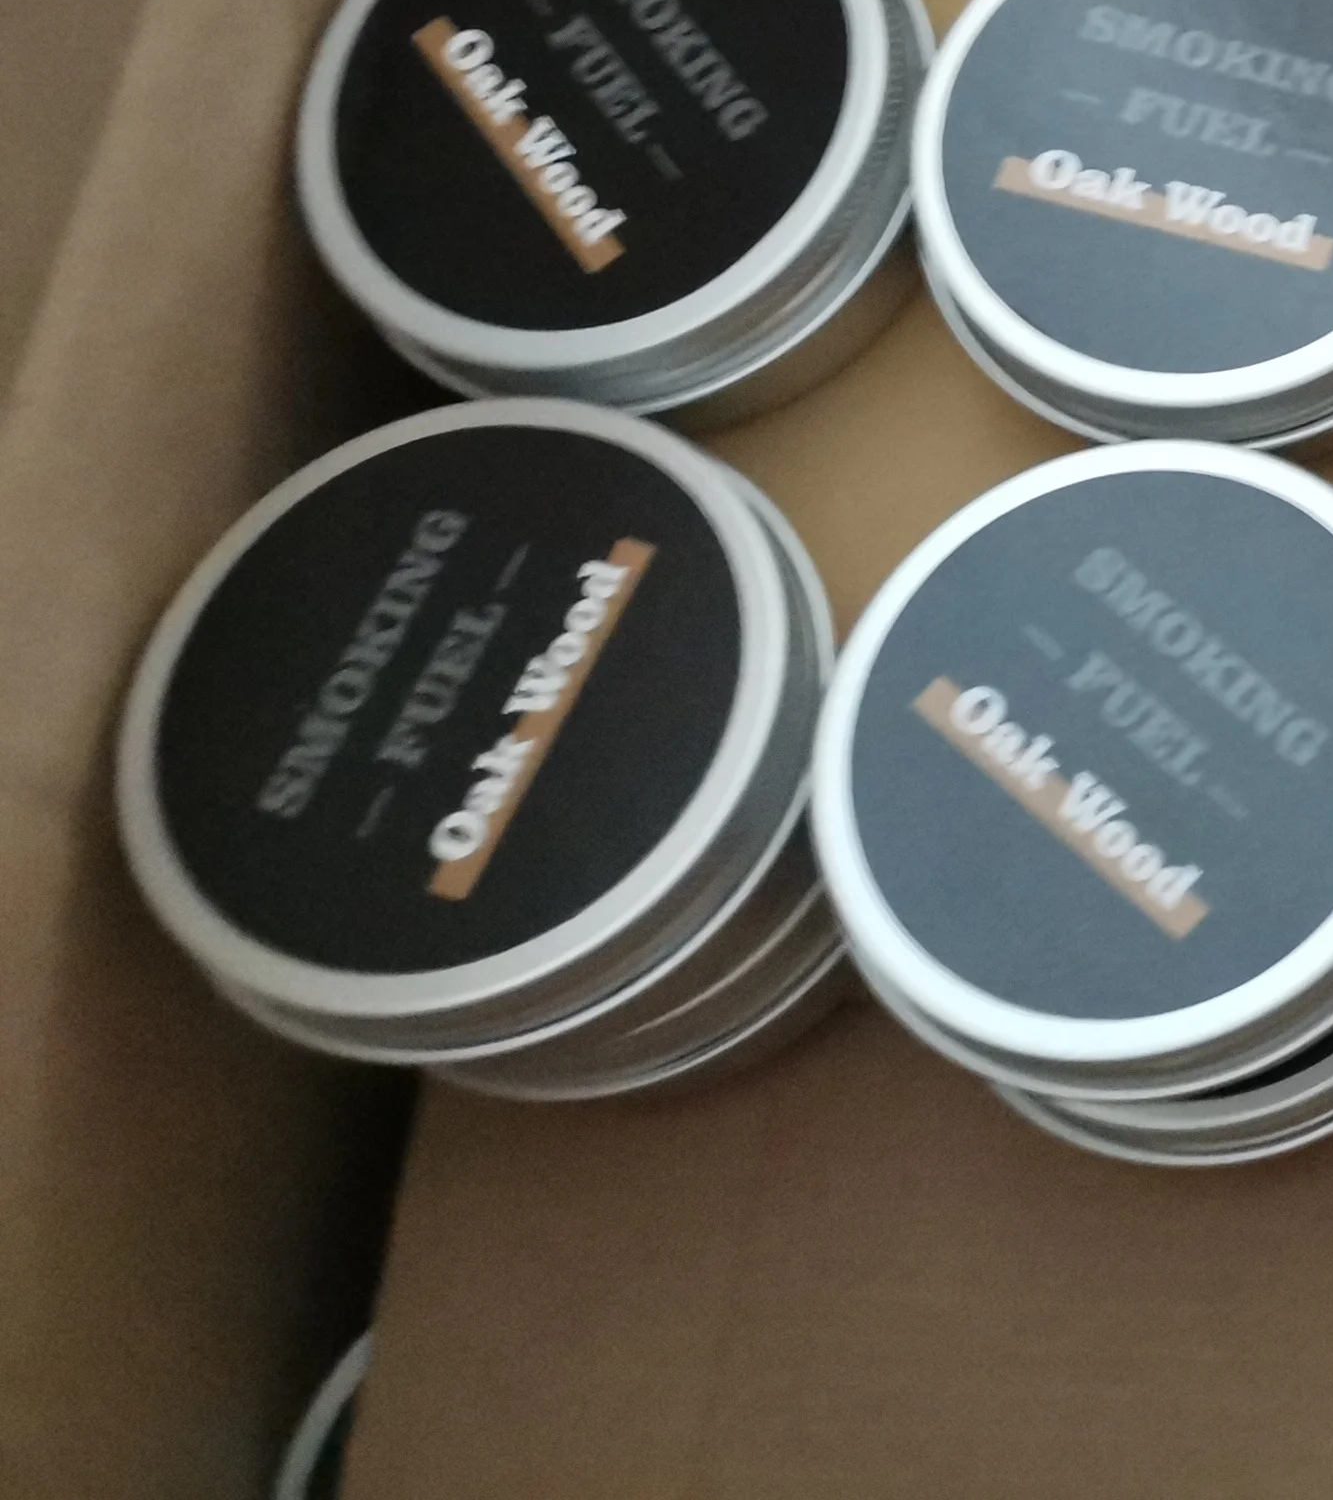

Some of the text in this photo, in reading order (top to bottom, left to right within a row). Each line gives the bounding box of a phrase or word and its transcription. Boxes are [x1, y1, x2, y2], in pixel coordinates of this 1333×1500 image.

[442, 28, 630, 247] Oak Wood
[542, 12, 663, 146] FUEL
[1116, 86, 1281, 159] FUEL
[1027, 147, 1320, 255] Oak Wood
[254, 508, 475, 822] SMOKING
[372, 602, 509, 772] FUEL
[425, 557, 632, 865] Oak Wood
[1065, 647, 1212, 788] FUEL
[1071, 545, 1332, 768] SMOKING
[949, 682, 1205, 912] Oak Wood
